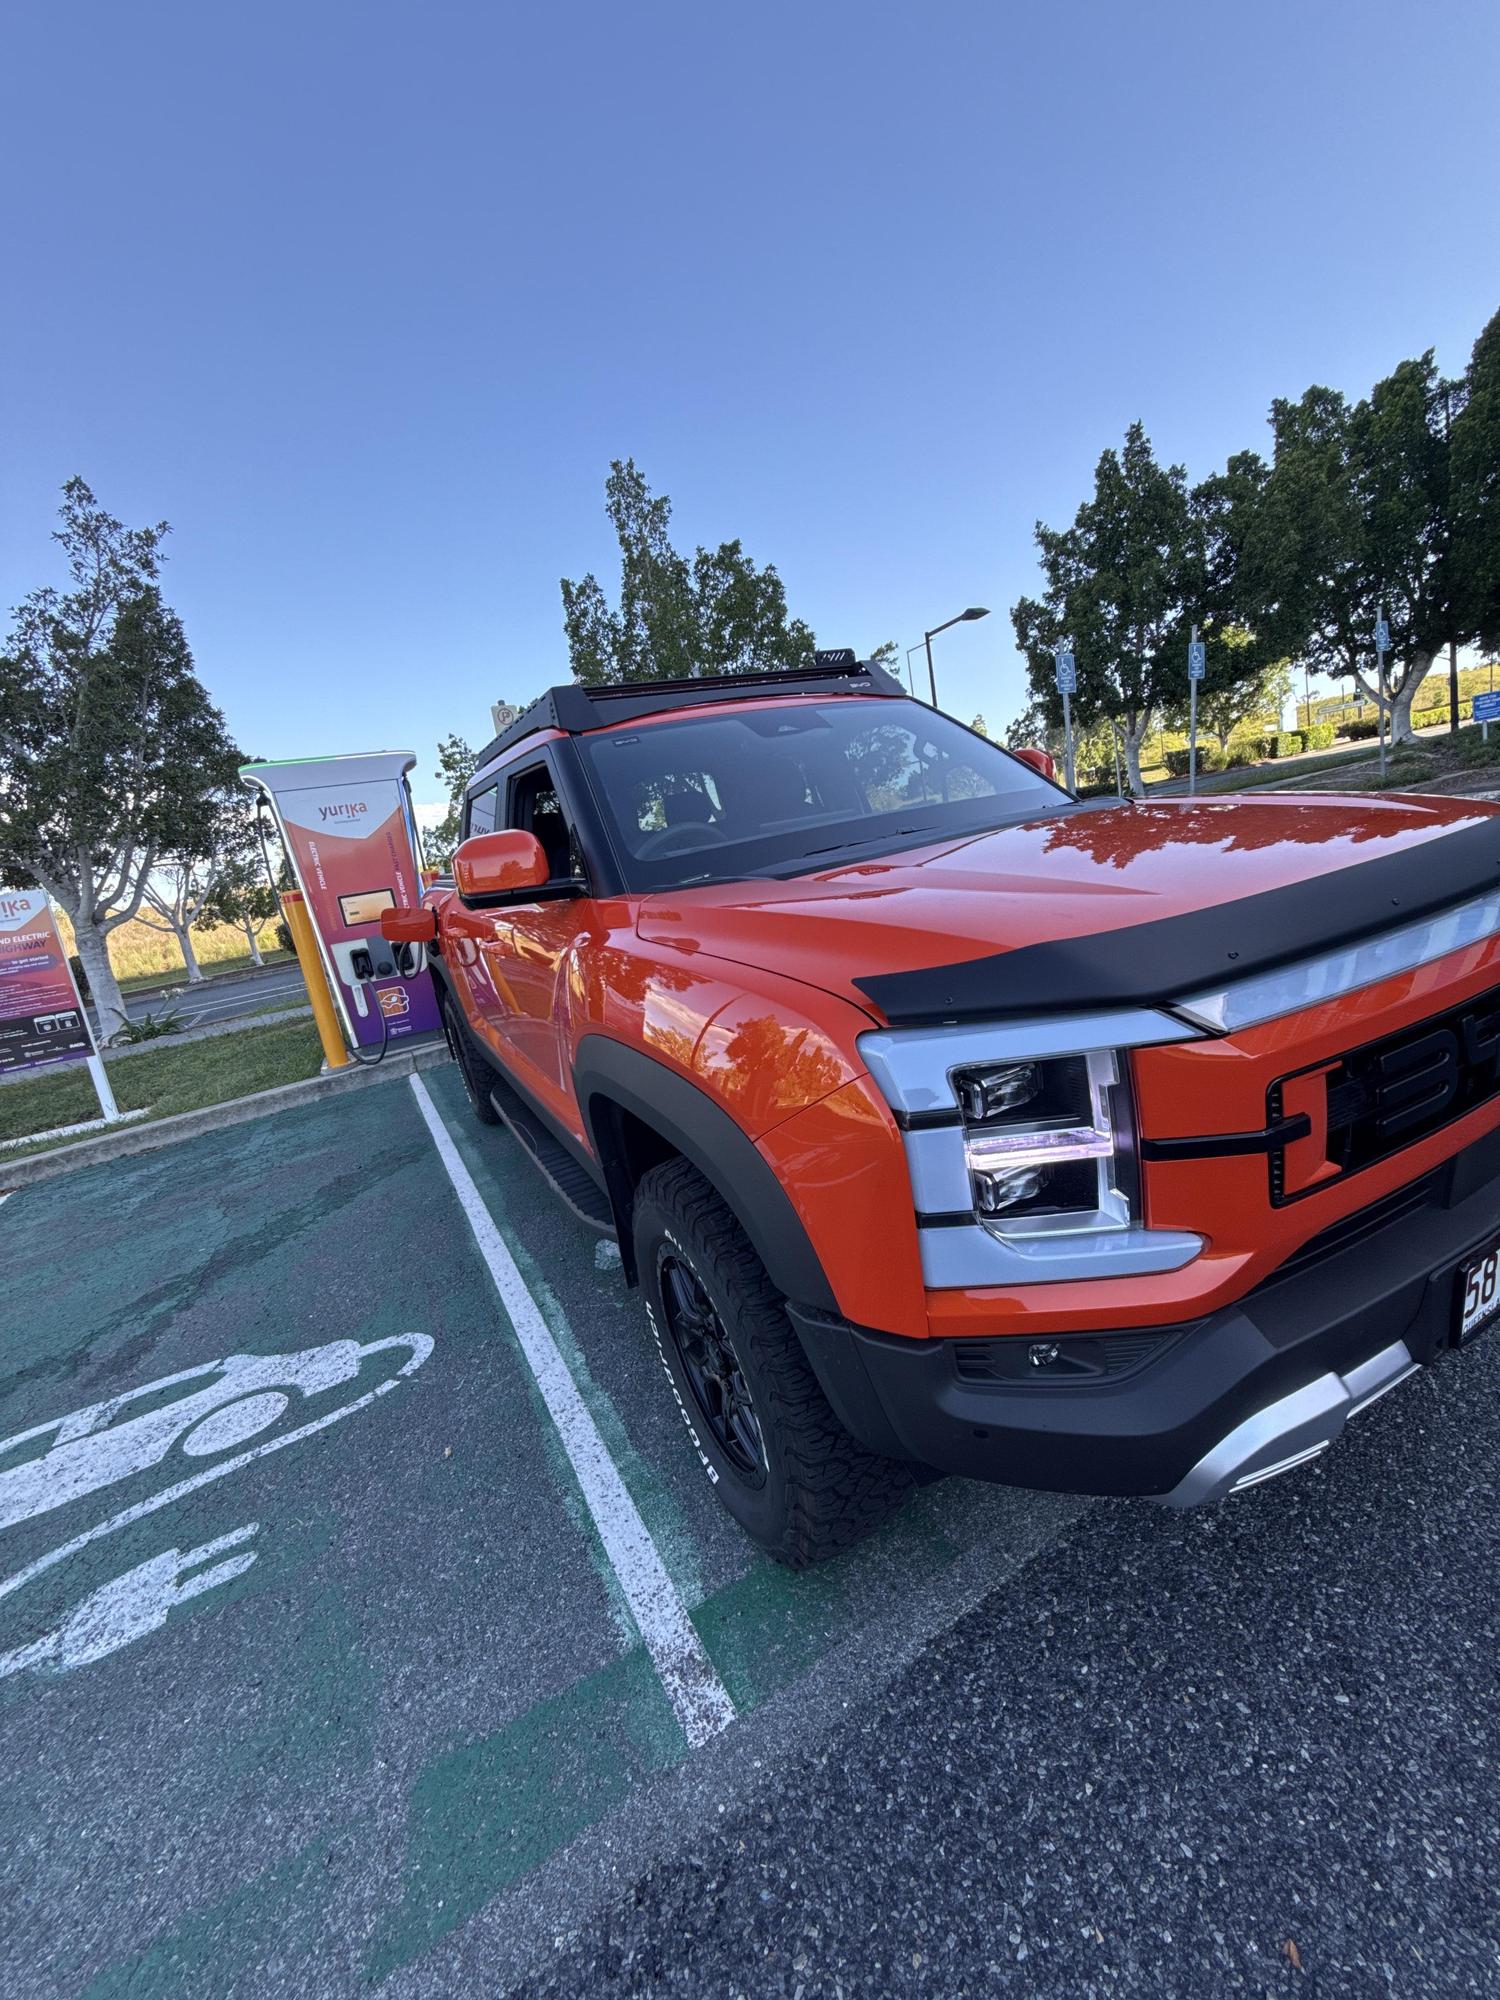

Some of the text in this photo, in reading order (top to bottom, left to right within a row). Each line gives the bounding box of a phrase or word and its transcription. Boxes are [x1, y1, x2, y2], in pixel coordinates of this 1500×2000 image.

[318, 802, 368, 821] yurika
[13, 931, 51, 943] ELECTRIC
[645, 1300, 720, 1485] BFGoodrich
